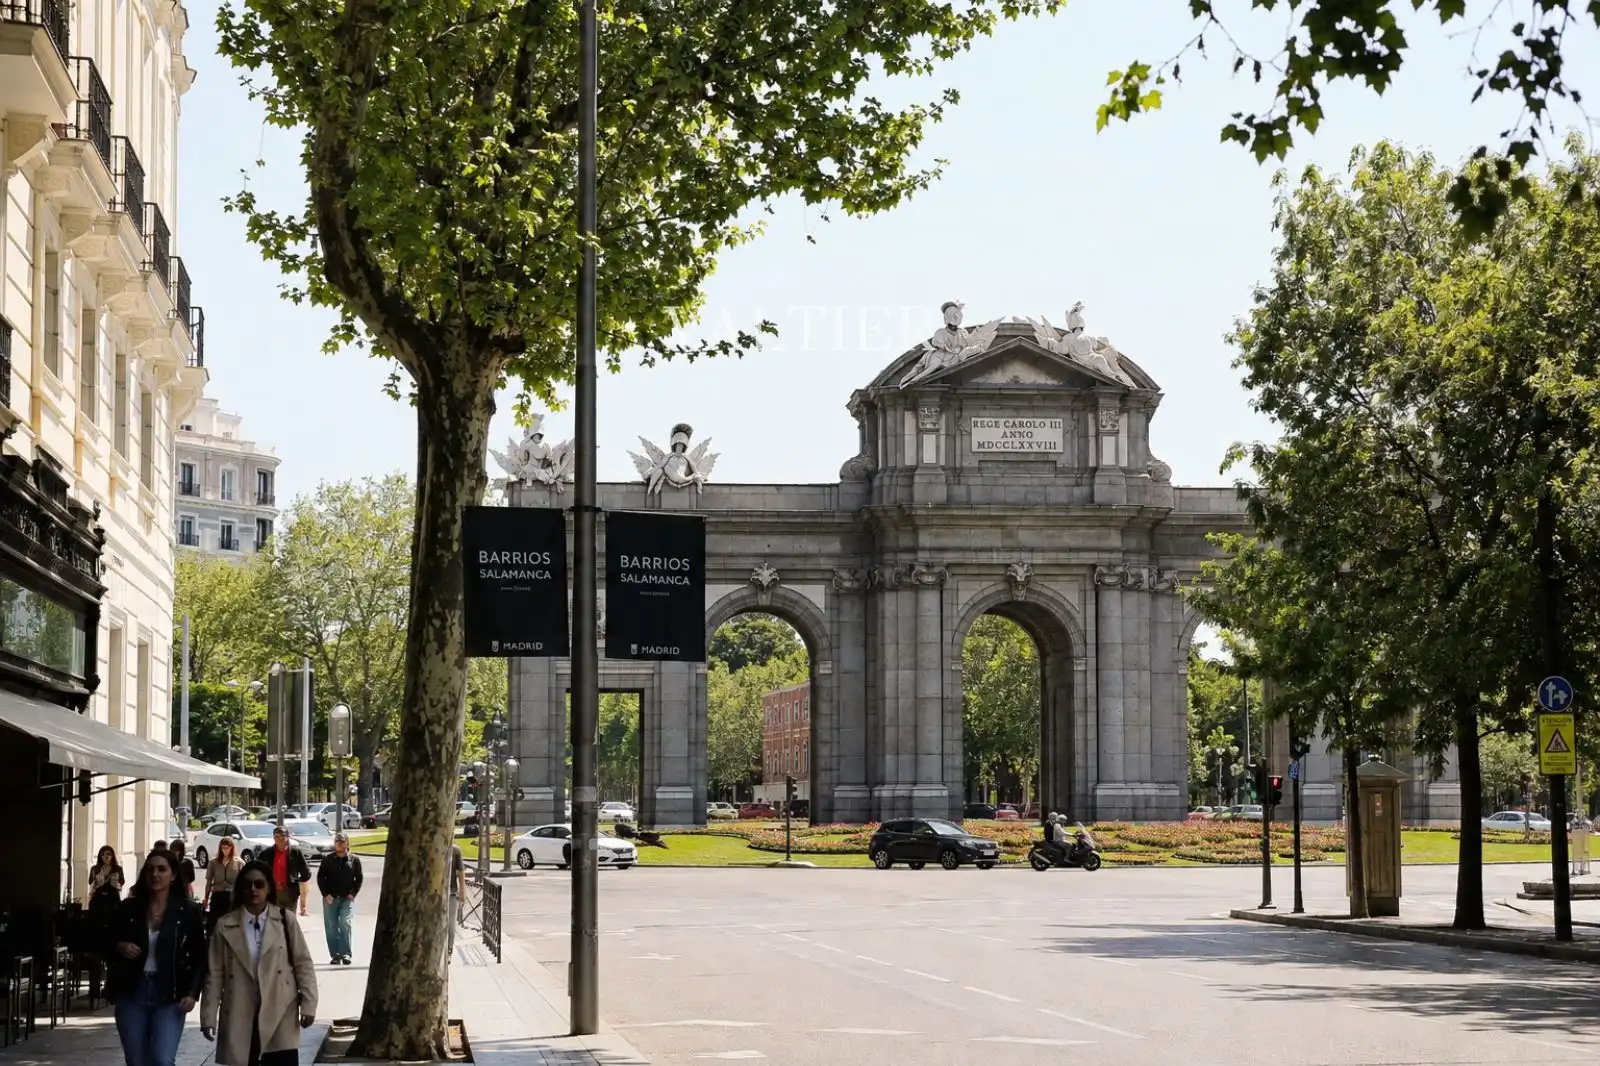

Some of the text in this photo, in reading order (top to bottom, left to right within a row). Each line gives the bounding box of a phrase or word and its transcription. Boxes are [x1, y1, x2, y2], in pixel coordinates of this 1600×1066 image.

[972, 419, 1062, 429] REGE CAROLO III
[1000, 430, 1034, 439] ANNO
[976, 440, 1057, 450] MDCCLXXVIII
[479, 550, 551, 565] BARRIOS
[620, 554, 691, 572] BARRIOS
[479, 568, 552, 581] SALAMANCA
[620, 573, 691, 586] SALAMANCA
[502, 641, 543, 651] MADRID
[641, 644, 680, 655] MADRID
